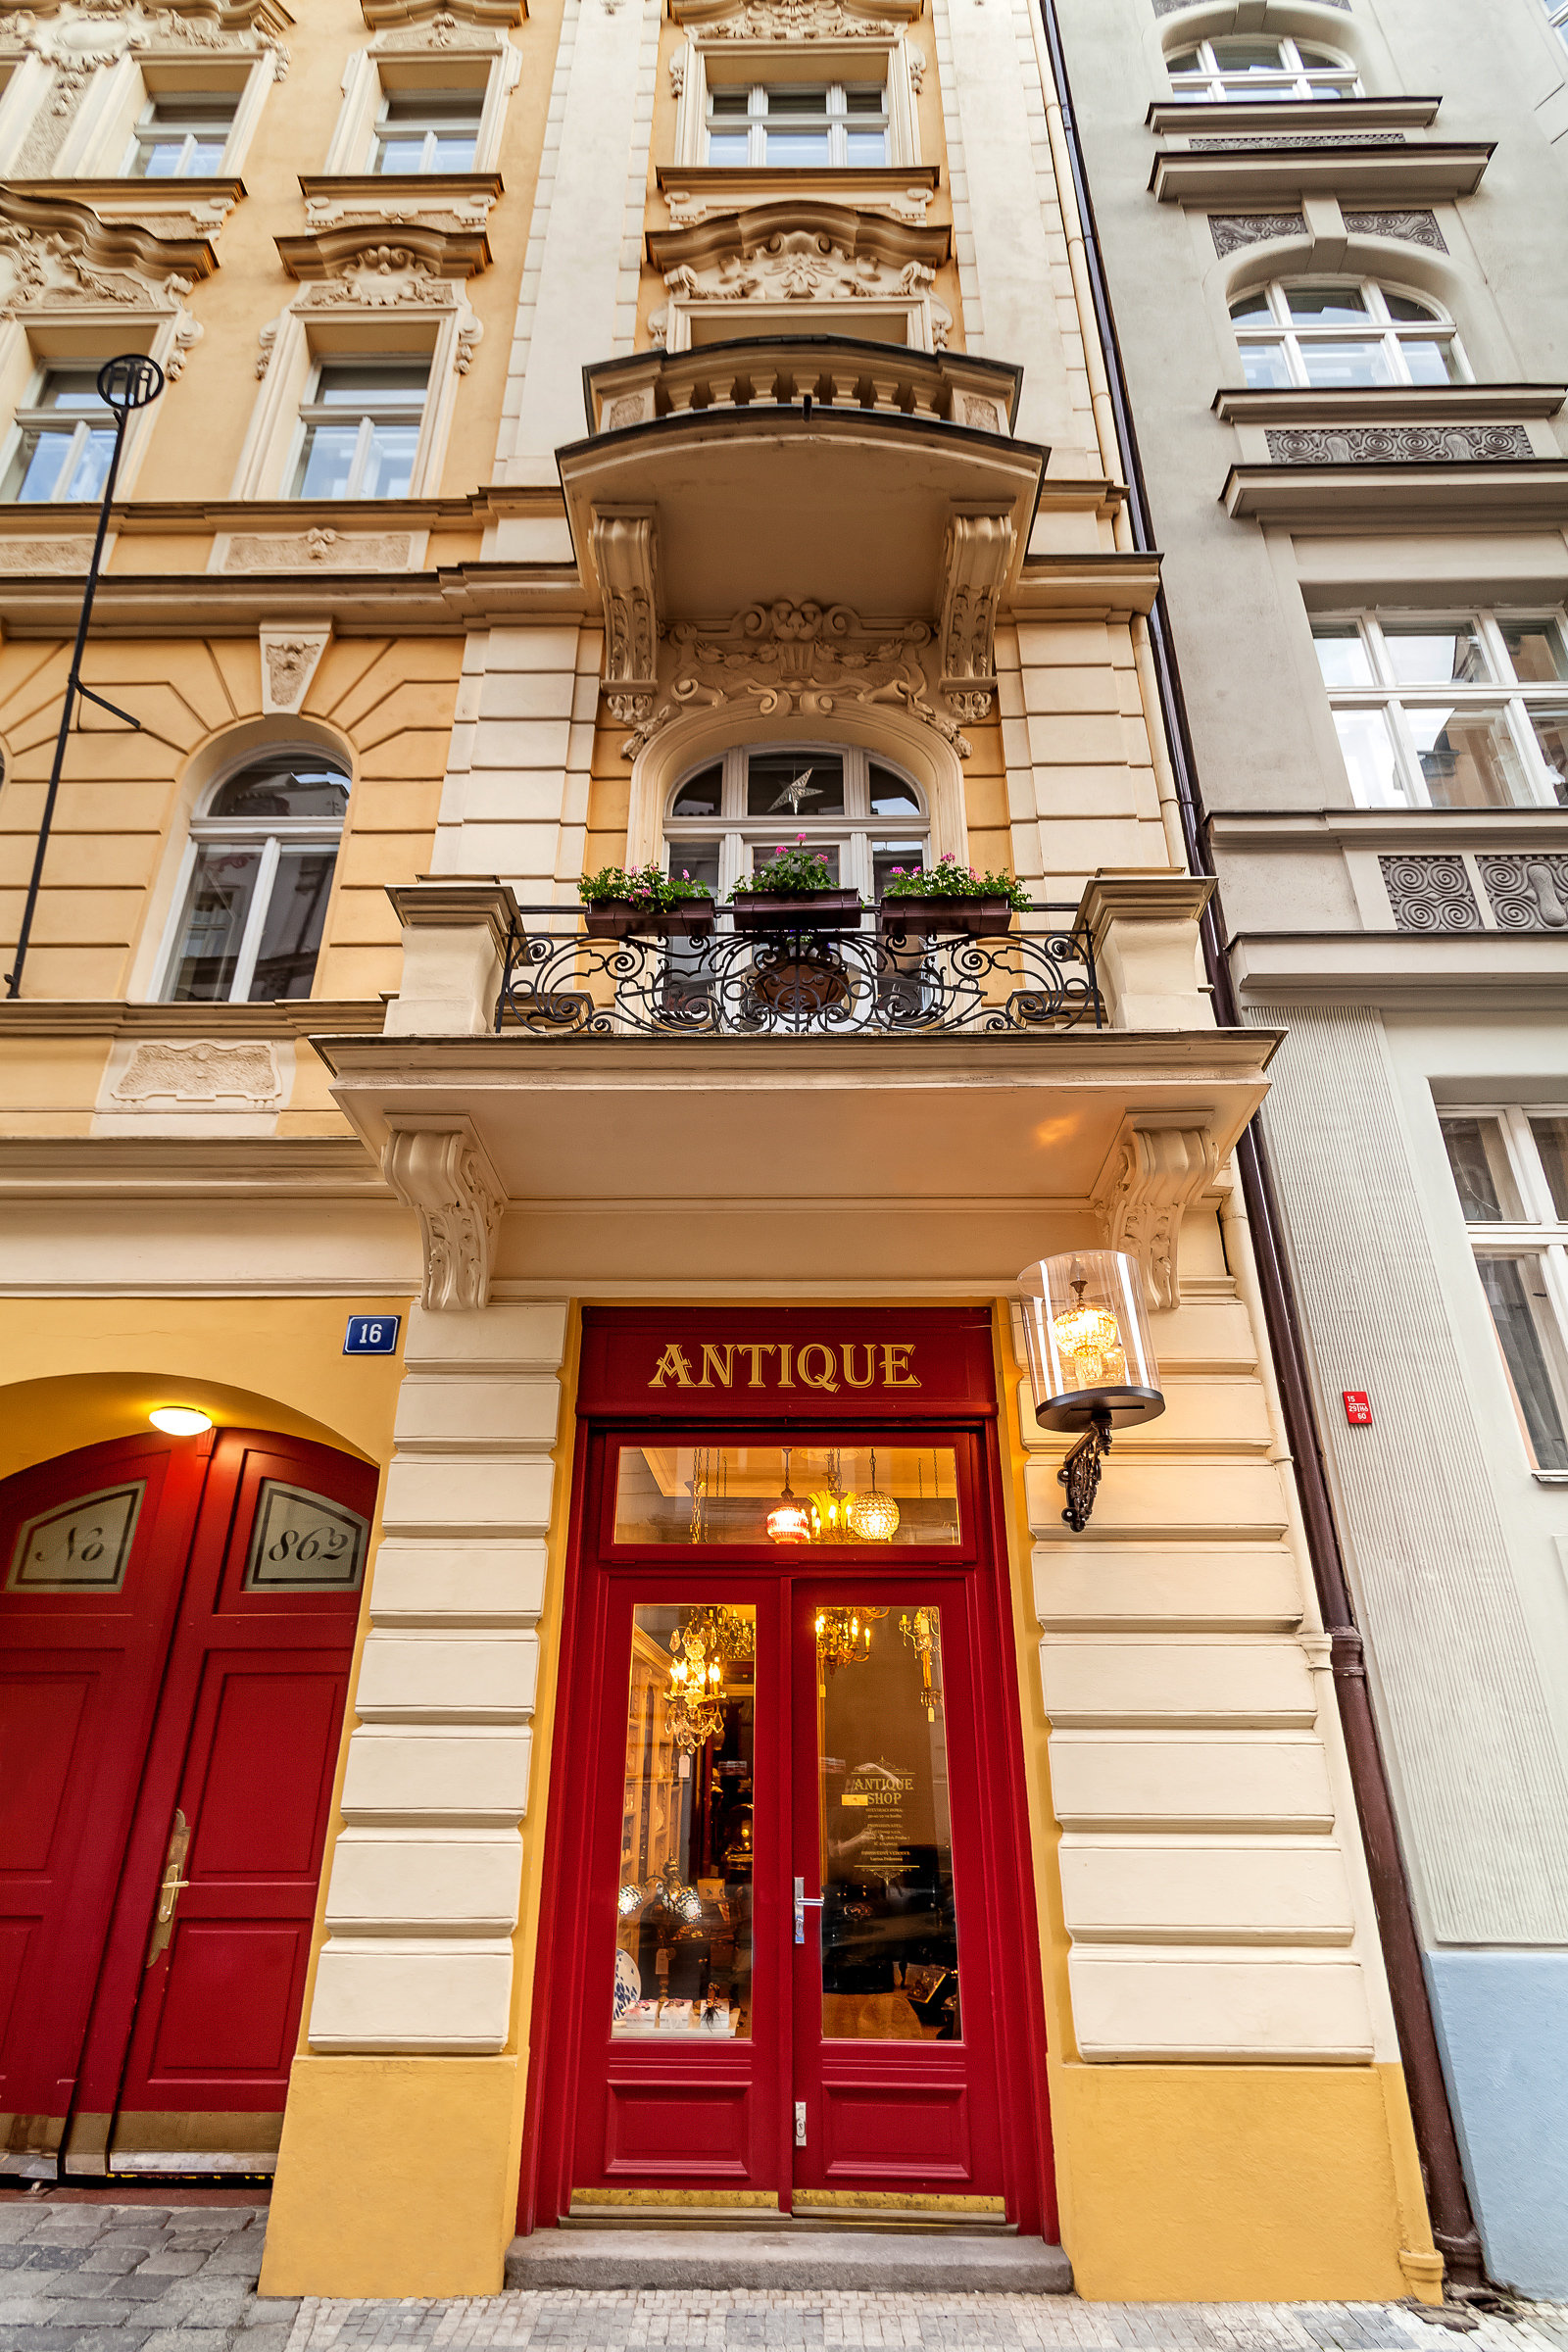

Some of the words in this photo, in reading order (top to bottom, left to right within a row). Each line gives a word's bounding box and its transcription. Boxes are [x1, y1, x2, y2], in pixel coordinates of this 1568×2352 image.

[359, 1323, 383, 1345] 16
[647, 1343, 923, 1394] ANTIQUE
[269, 1526, 349, 1562] 862
[855, 1778, 914, 1791] ANTIQUE
[867, 1793, 902, 1805] SHOP
